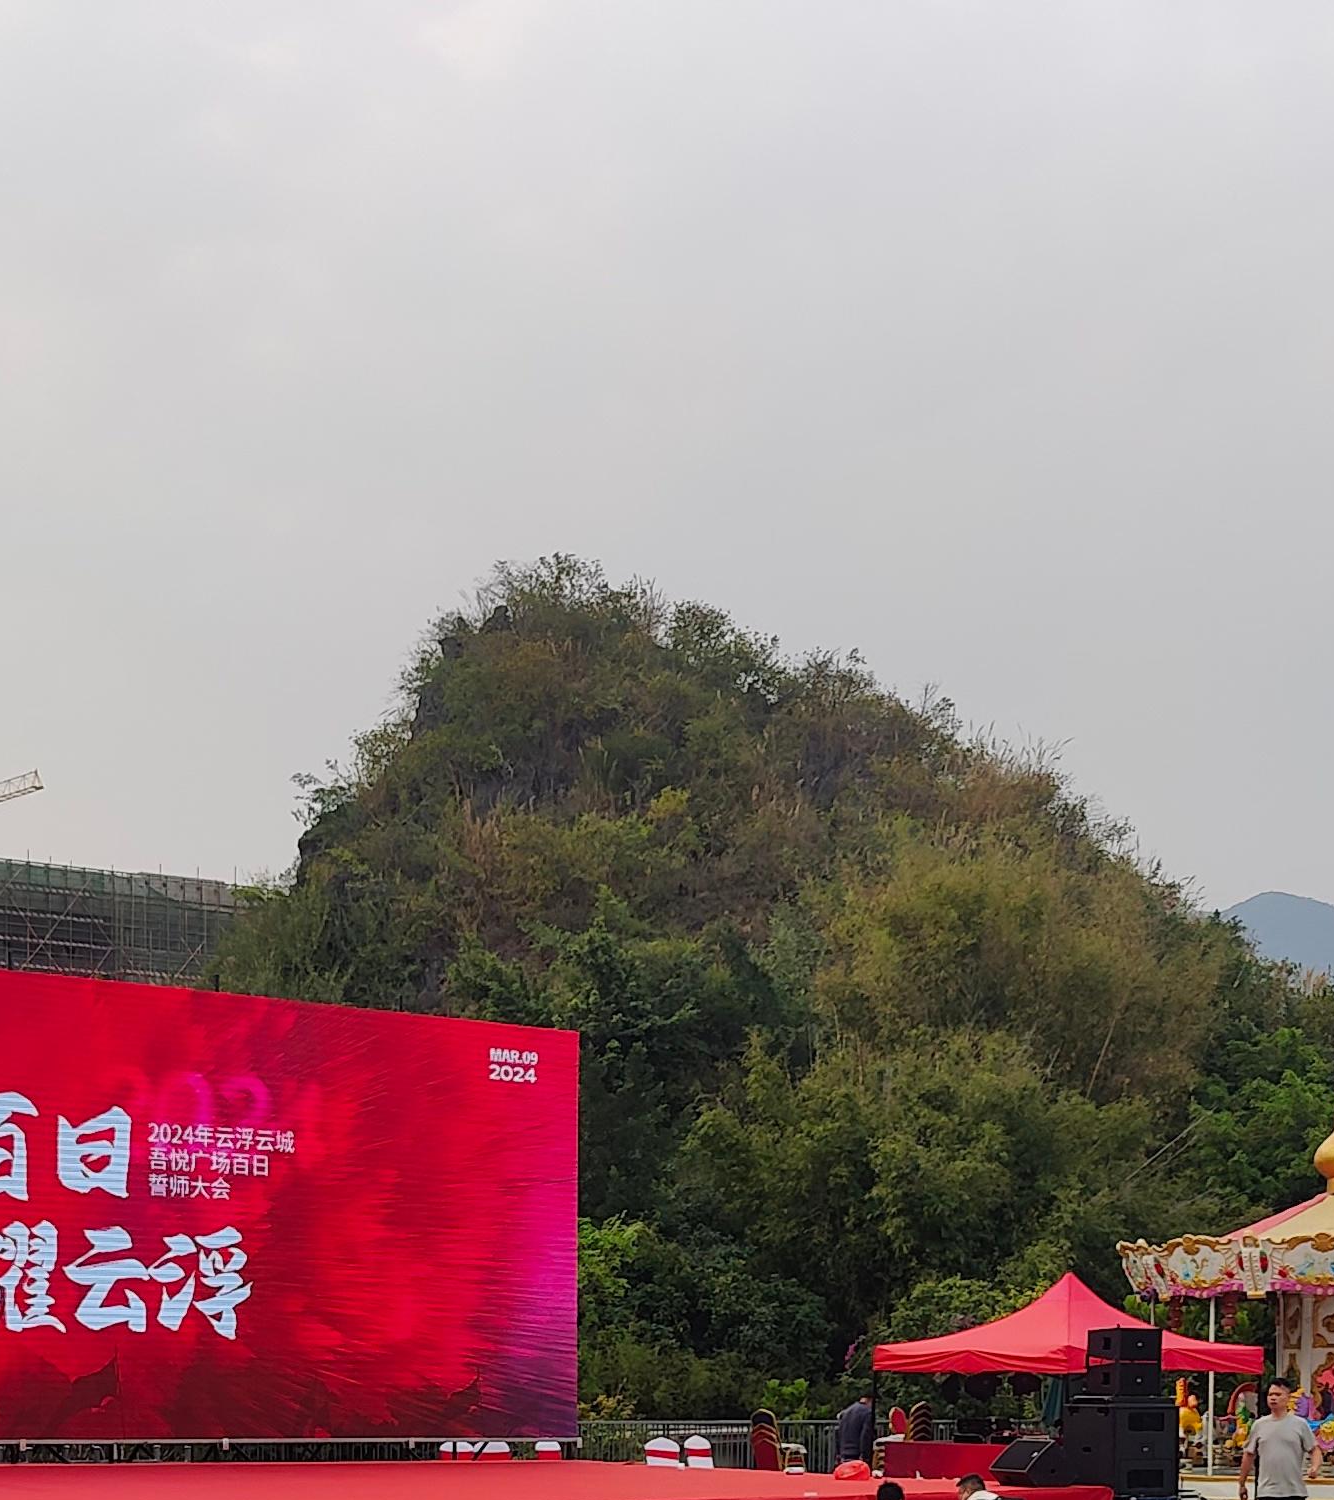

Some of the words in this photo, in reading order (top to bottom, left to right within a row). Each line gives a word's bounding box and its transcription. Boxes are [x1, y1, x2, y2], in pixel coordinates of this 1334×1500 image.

[489, 1063, 538, 1084] 2024
[147, 1122, 296, 1153] 2024年云浮云城
[148, 1147, 269, 1177] 吾悦广场百日
[148, 1173, 231, 1200] 誓师大会
